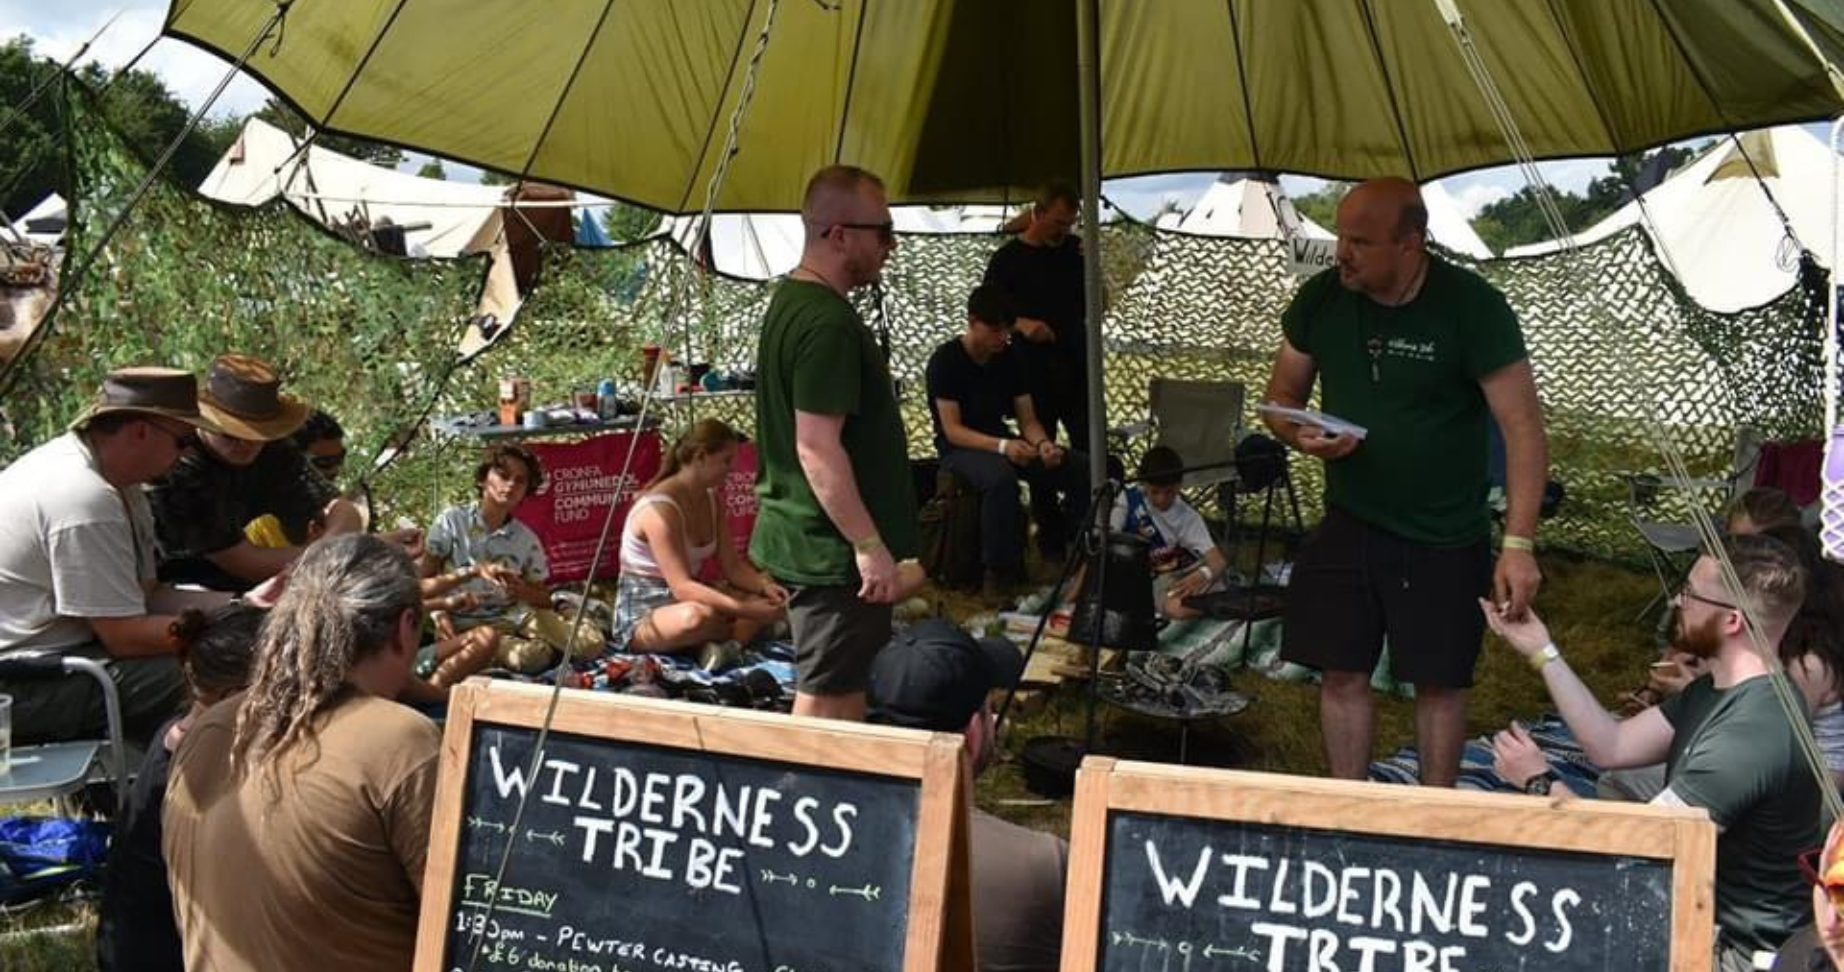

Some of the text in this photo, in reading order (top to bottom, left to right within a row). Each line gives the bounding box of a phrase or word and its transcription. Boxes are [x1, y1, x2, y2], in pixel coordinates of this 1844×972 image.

[553, 466, 601, 481] CRONFA
[554, 509, 590, 524] FUND
[488, 746, 858, 858] WILDERNESS
[573, 816, 746, 894] TRIBE
[464, 873, 558, 911] FRIDAY
[1144, 840, 1581, 952] WILDERNESS
[557, 925, 645, 959] PEWTER
[652, 948, 744, 972] CASTING
